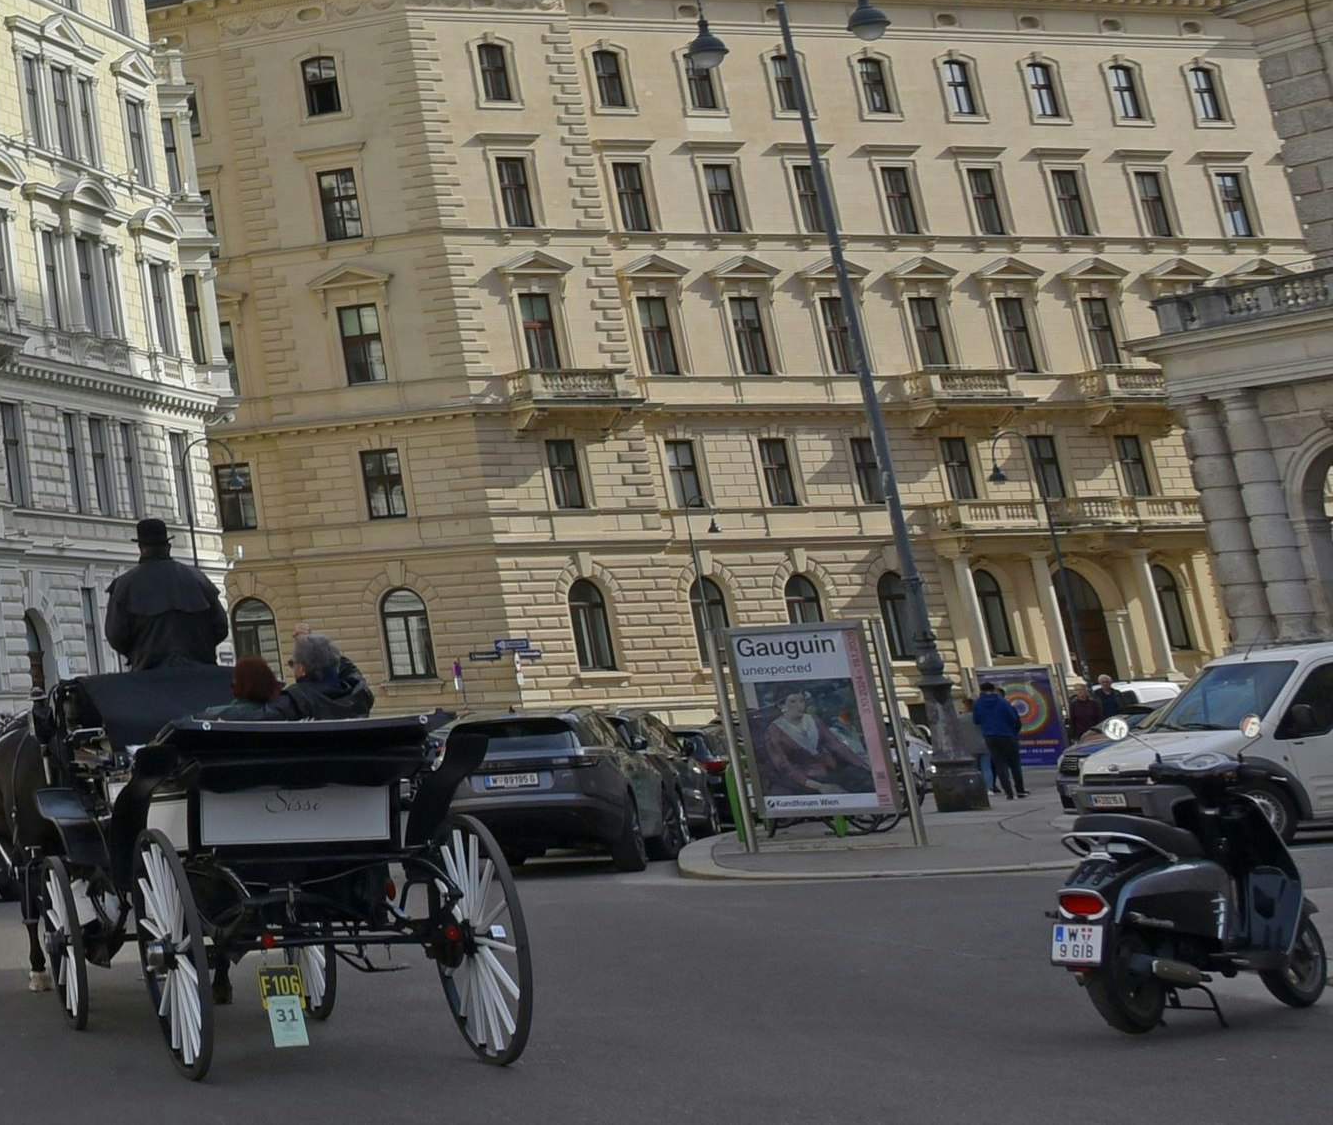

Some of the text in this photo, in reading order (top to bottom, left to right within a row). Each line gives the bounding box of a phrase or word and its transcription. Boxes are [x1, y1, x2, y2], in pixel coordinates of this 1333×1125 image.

[736, 635, 836, 660] Gauguin
[741, 662, 812, 676] unexpected
[776, 797, 840, 808] Kunstforum Wien
[1068, 927, 1079, 942] W
[1060, 943, 1068, 958] 9
[276, 1008, 299, 1023] 31
